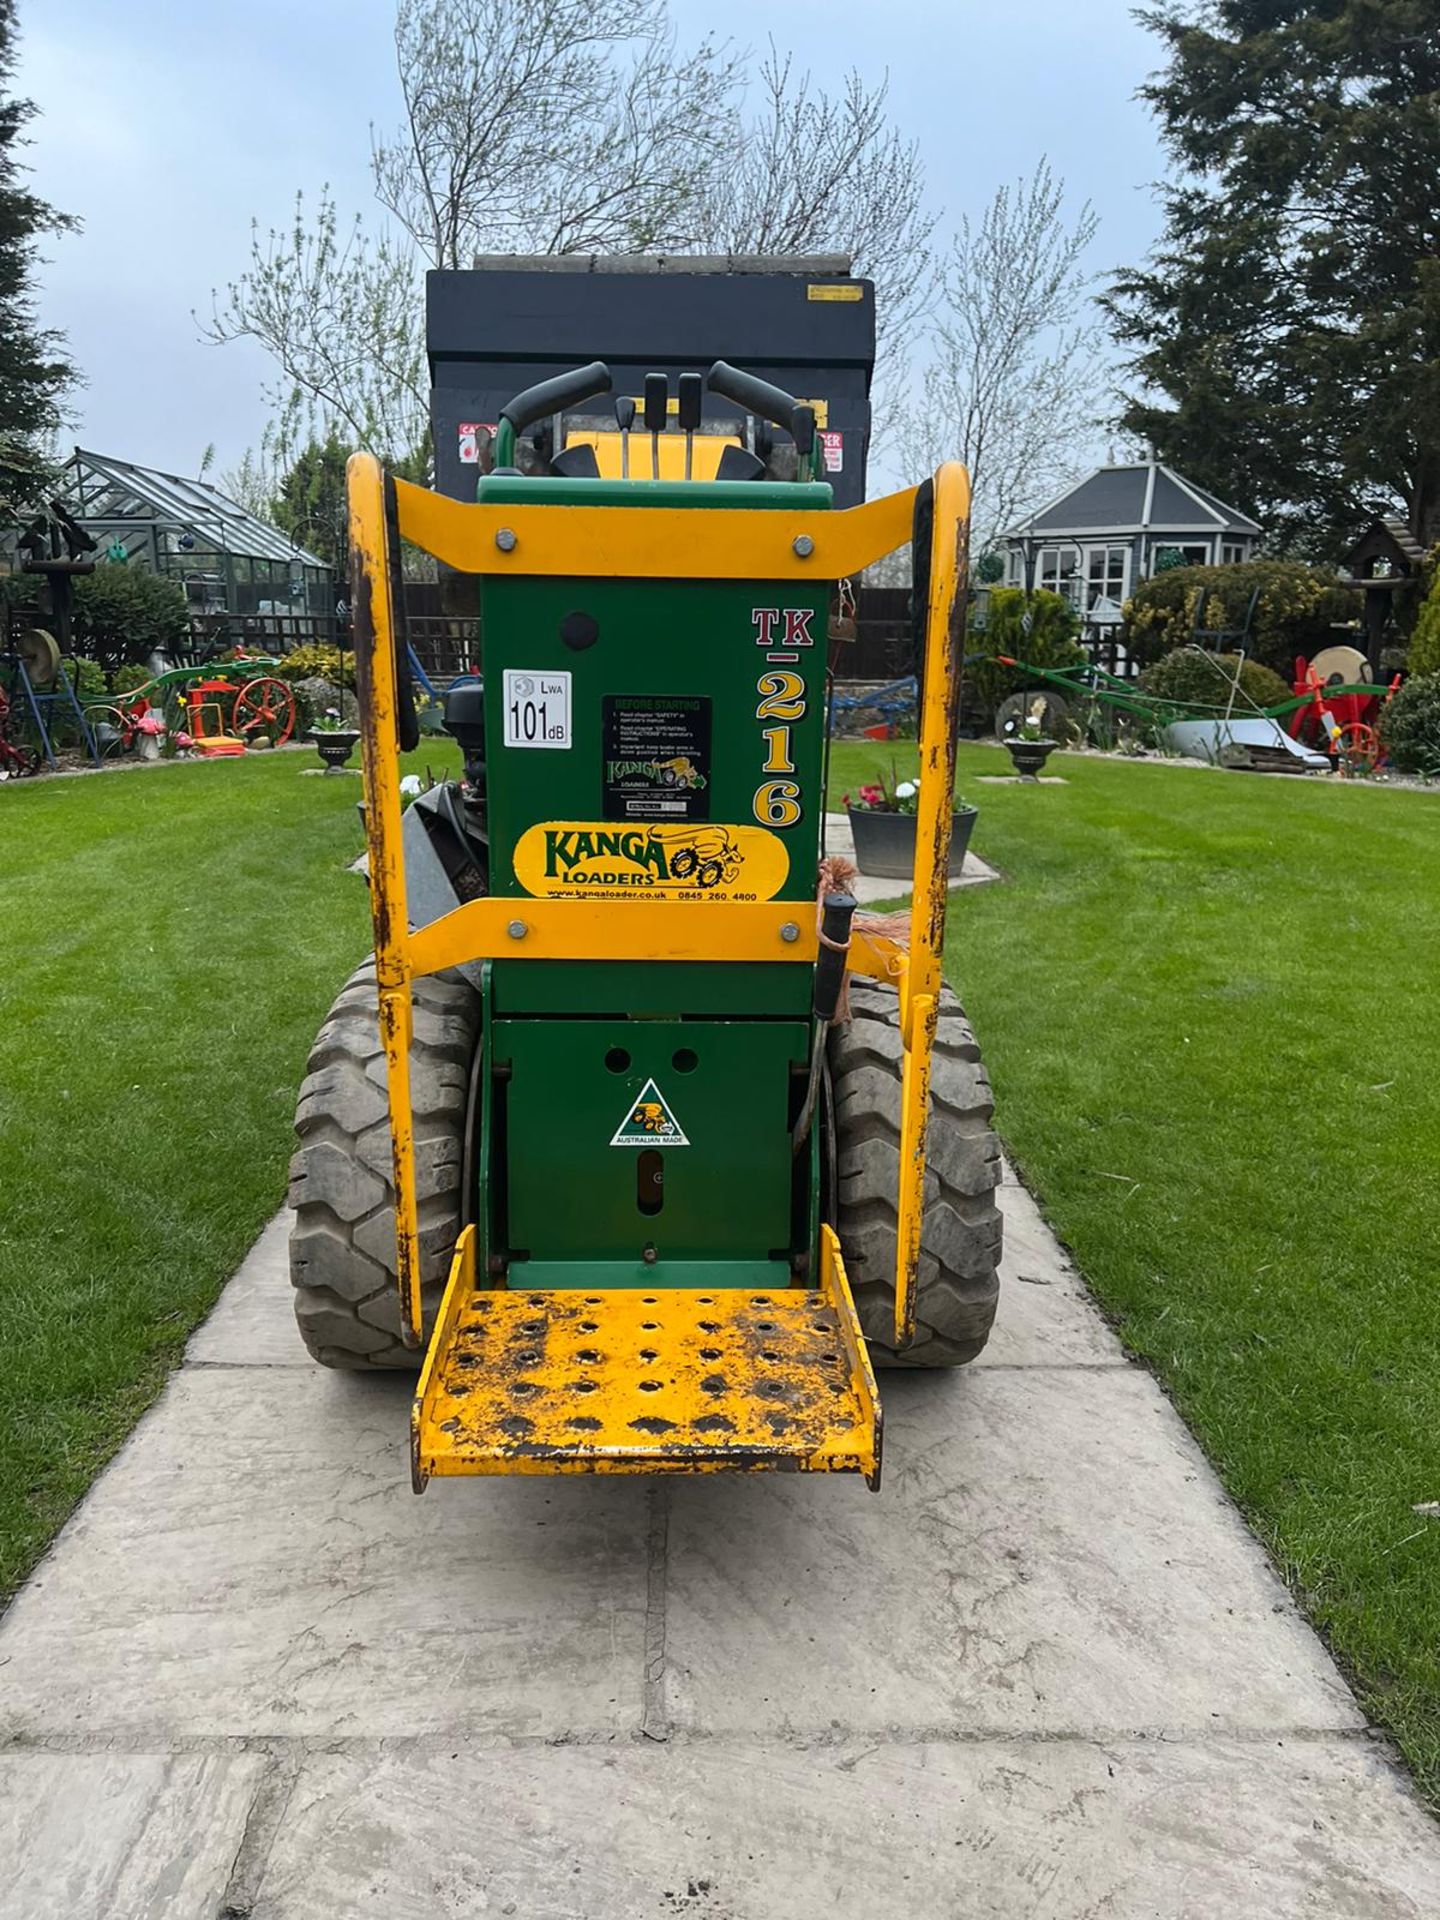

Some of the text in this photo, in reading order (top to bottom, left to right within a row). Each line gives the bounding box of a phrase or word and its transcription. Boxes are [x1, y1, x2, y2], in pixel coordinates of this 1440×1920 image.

[511, 700, 564, 740] 101 dB
[607, 760, 663, 784] KANGA
[544, 830, 671, 881] KANGA
[562, 871, 655, 886] LOADERS
[678, 891, 703, 900] 0845
[708, 892, 727, 901] 260
[617, 1136, 683, 1144] AUSTRALIAN MADE
